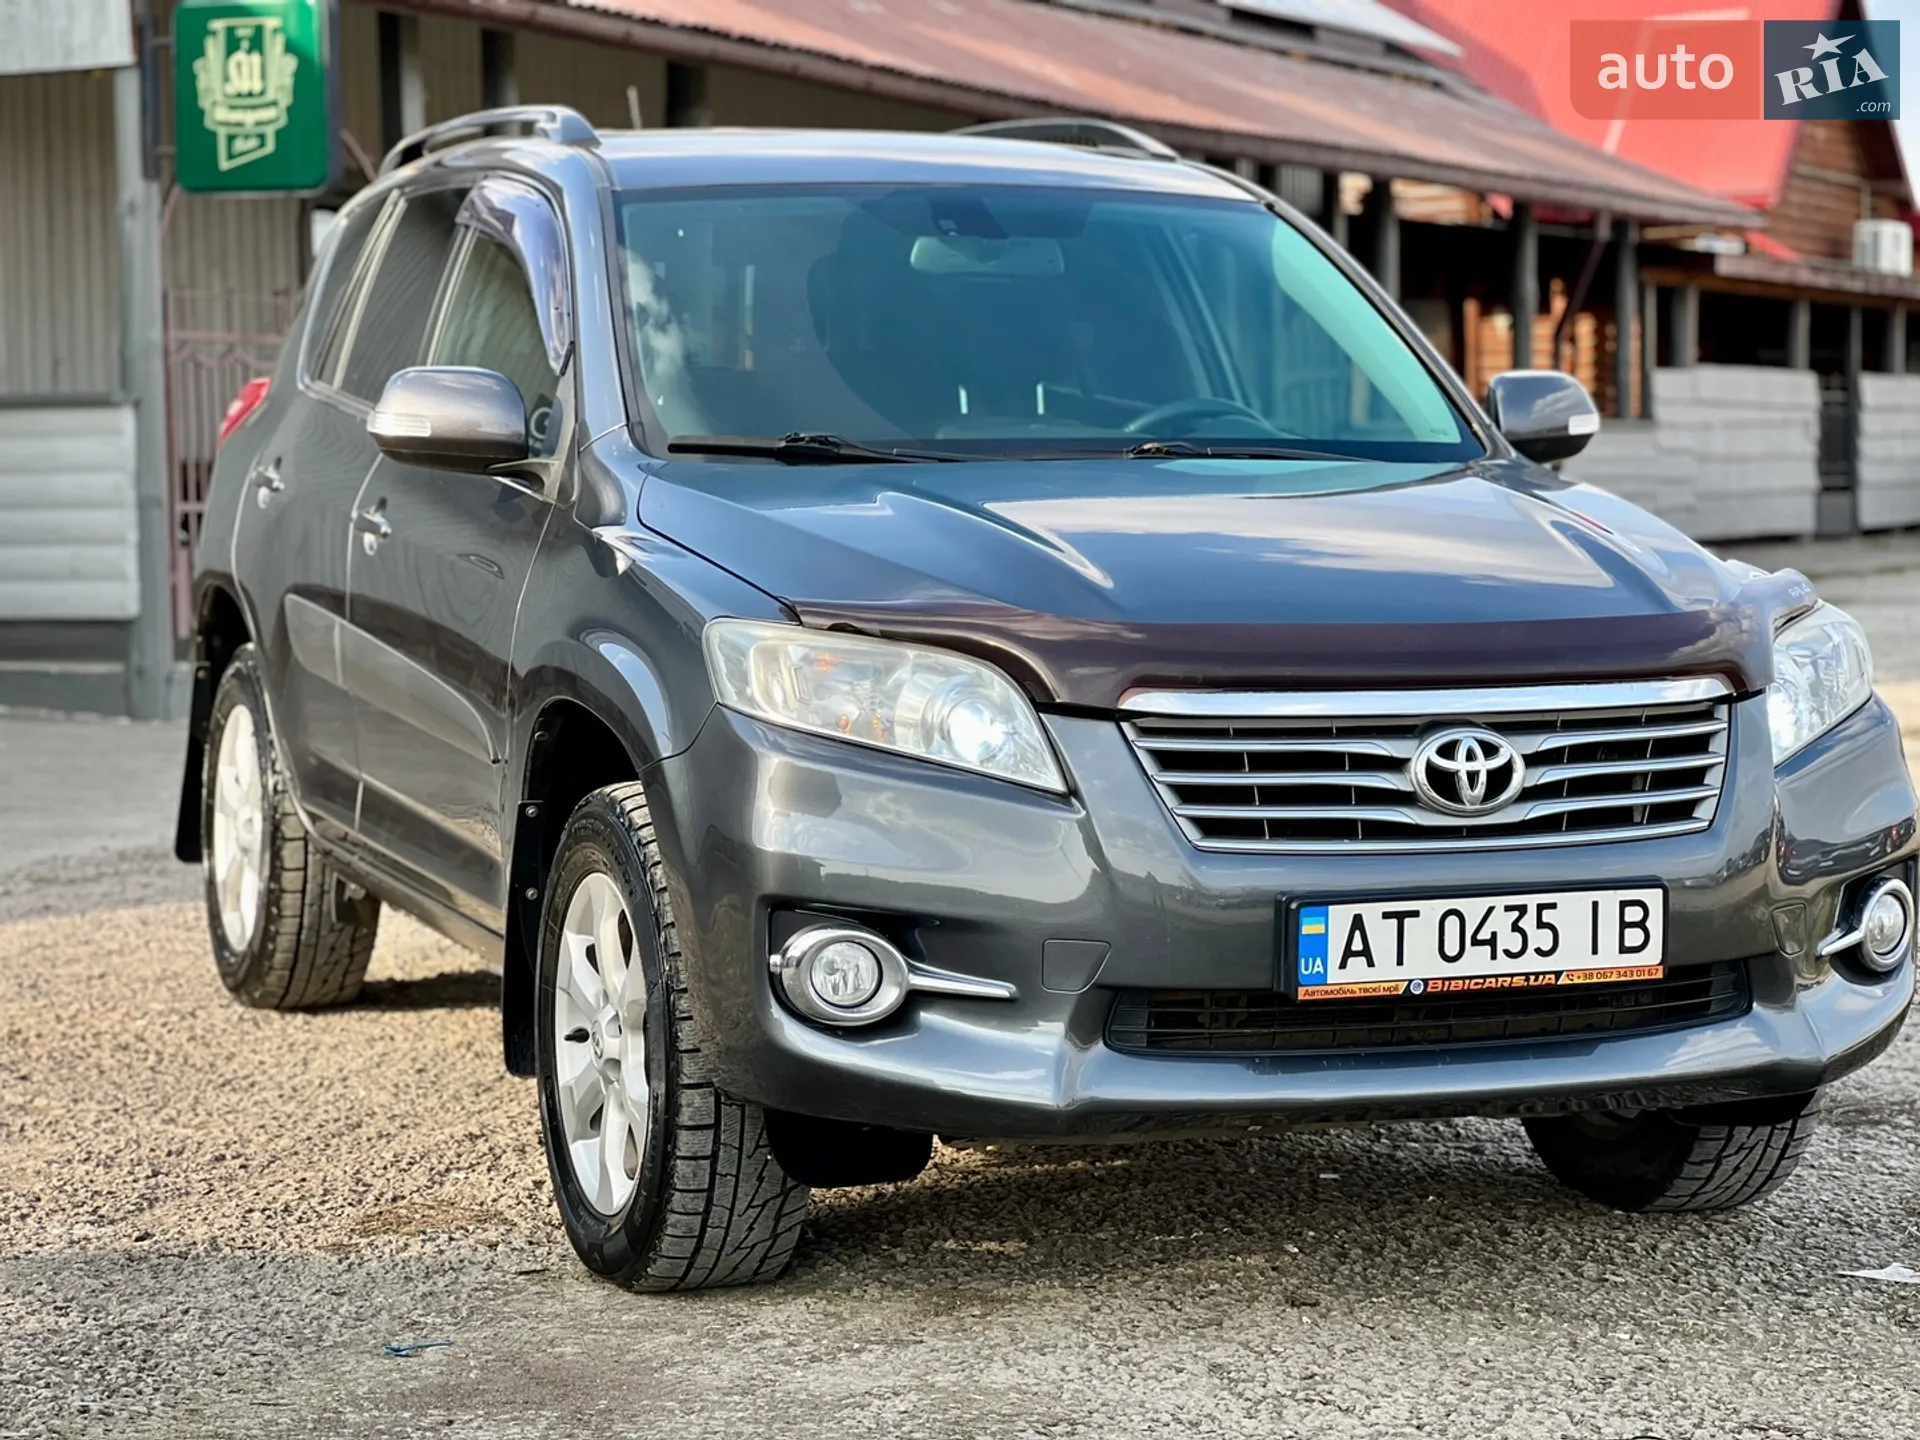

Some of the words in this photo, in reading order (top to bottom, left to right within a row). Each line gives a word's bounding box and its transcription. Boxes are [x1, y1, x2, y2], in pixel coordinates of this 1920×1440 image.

[1337, 909, 1421, 970] AT
[1437, 902, 1560, 964] 0435
[1591, 899, 1651, 956] IB
[1301, 957, 1324, 975] UA
[1426, 974, 1556, 993] BIBICARS.UA
[1576, 972, 1594, 981] +38
[1595, 971, 1614, 980] 067
[1303, 987, 1357, 998] Автомобіль
